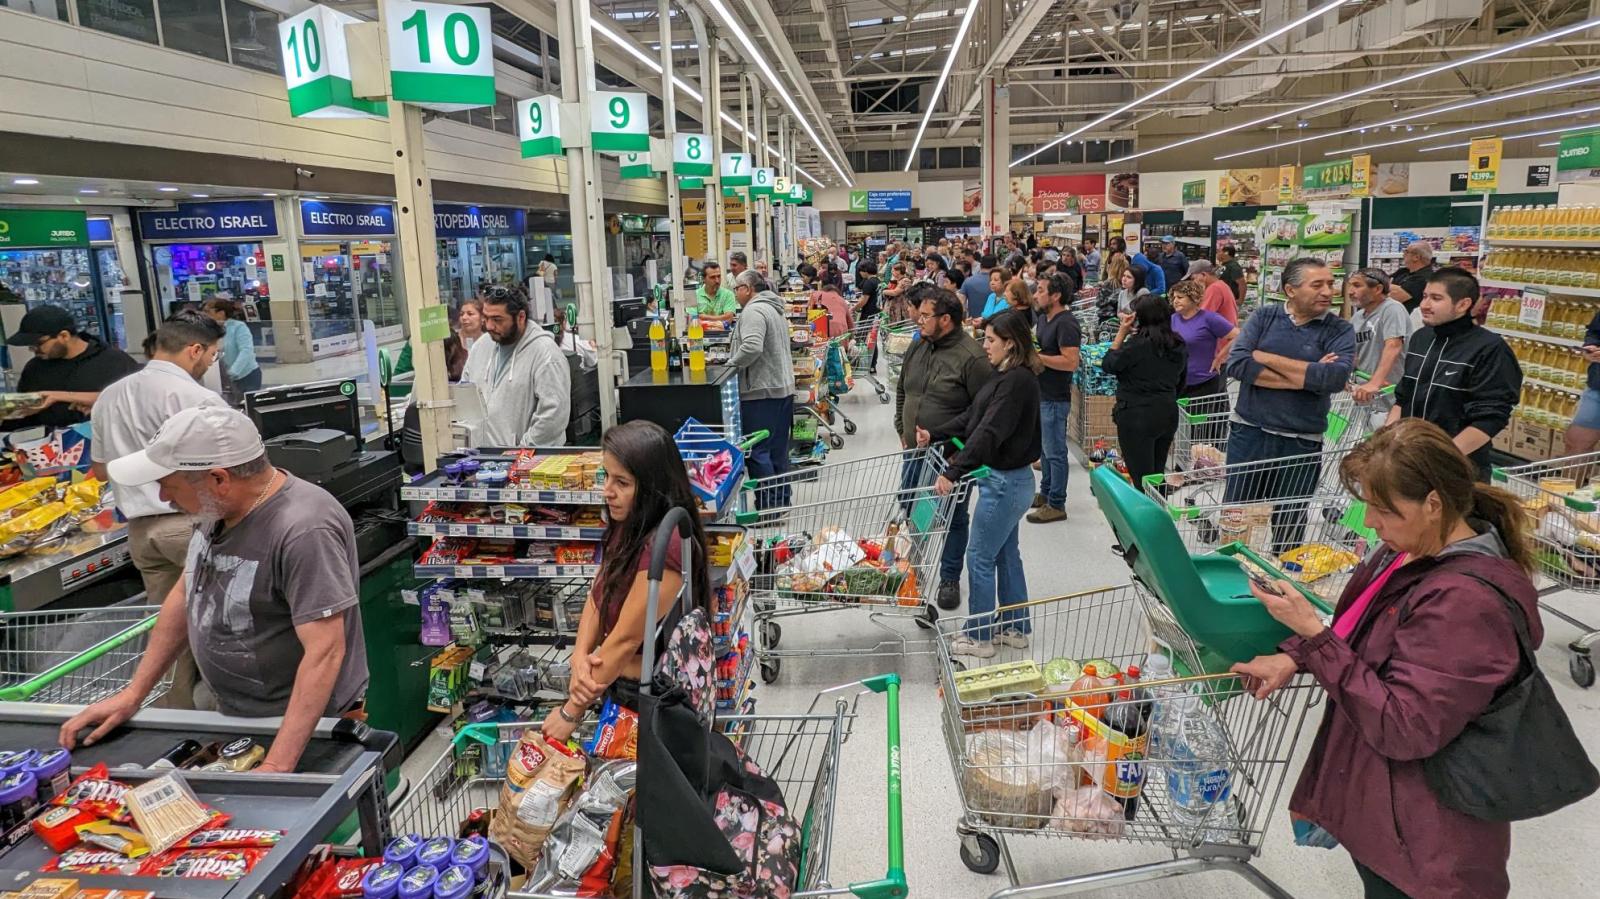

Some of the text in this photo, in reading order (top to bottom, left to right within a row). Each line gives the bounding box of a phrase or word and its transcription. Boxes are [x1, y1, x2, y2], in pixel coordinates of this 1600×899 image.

[401, 9, 481, 66] 10
[286, 18, 321, 78] 10
[529, 101, 543, 135] 9
[608, 96, 631, 130] 9
[686, 136, 702, 161] 8
[1560, 146, 1590, 158] JUMBO
[730, 155, 743, 175] 7
[756, 168, 767, 185] 6
[776, 178, 785, 192] 5
[790, 185, 797, 197] 4
[1042, 195, 1099, 213] pasles
[155, 216, 268, 230] ELECTRO ISRAEL
[311, 211, 386, 226] ELECTRO ISRAEL
[433, 213, 509, 229] RTOPEDIA ISRAEL
[1306, 223, 1325, 235] VIVO
